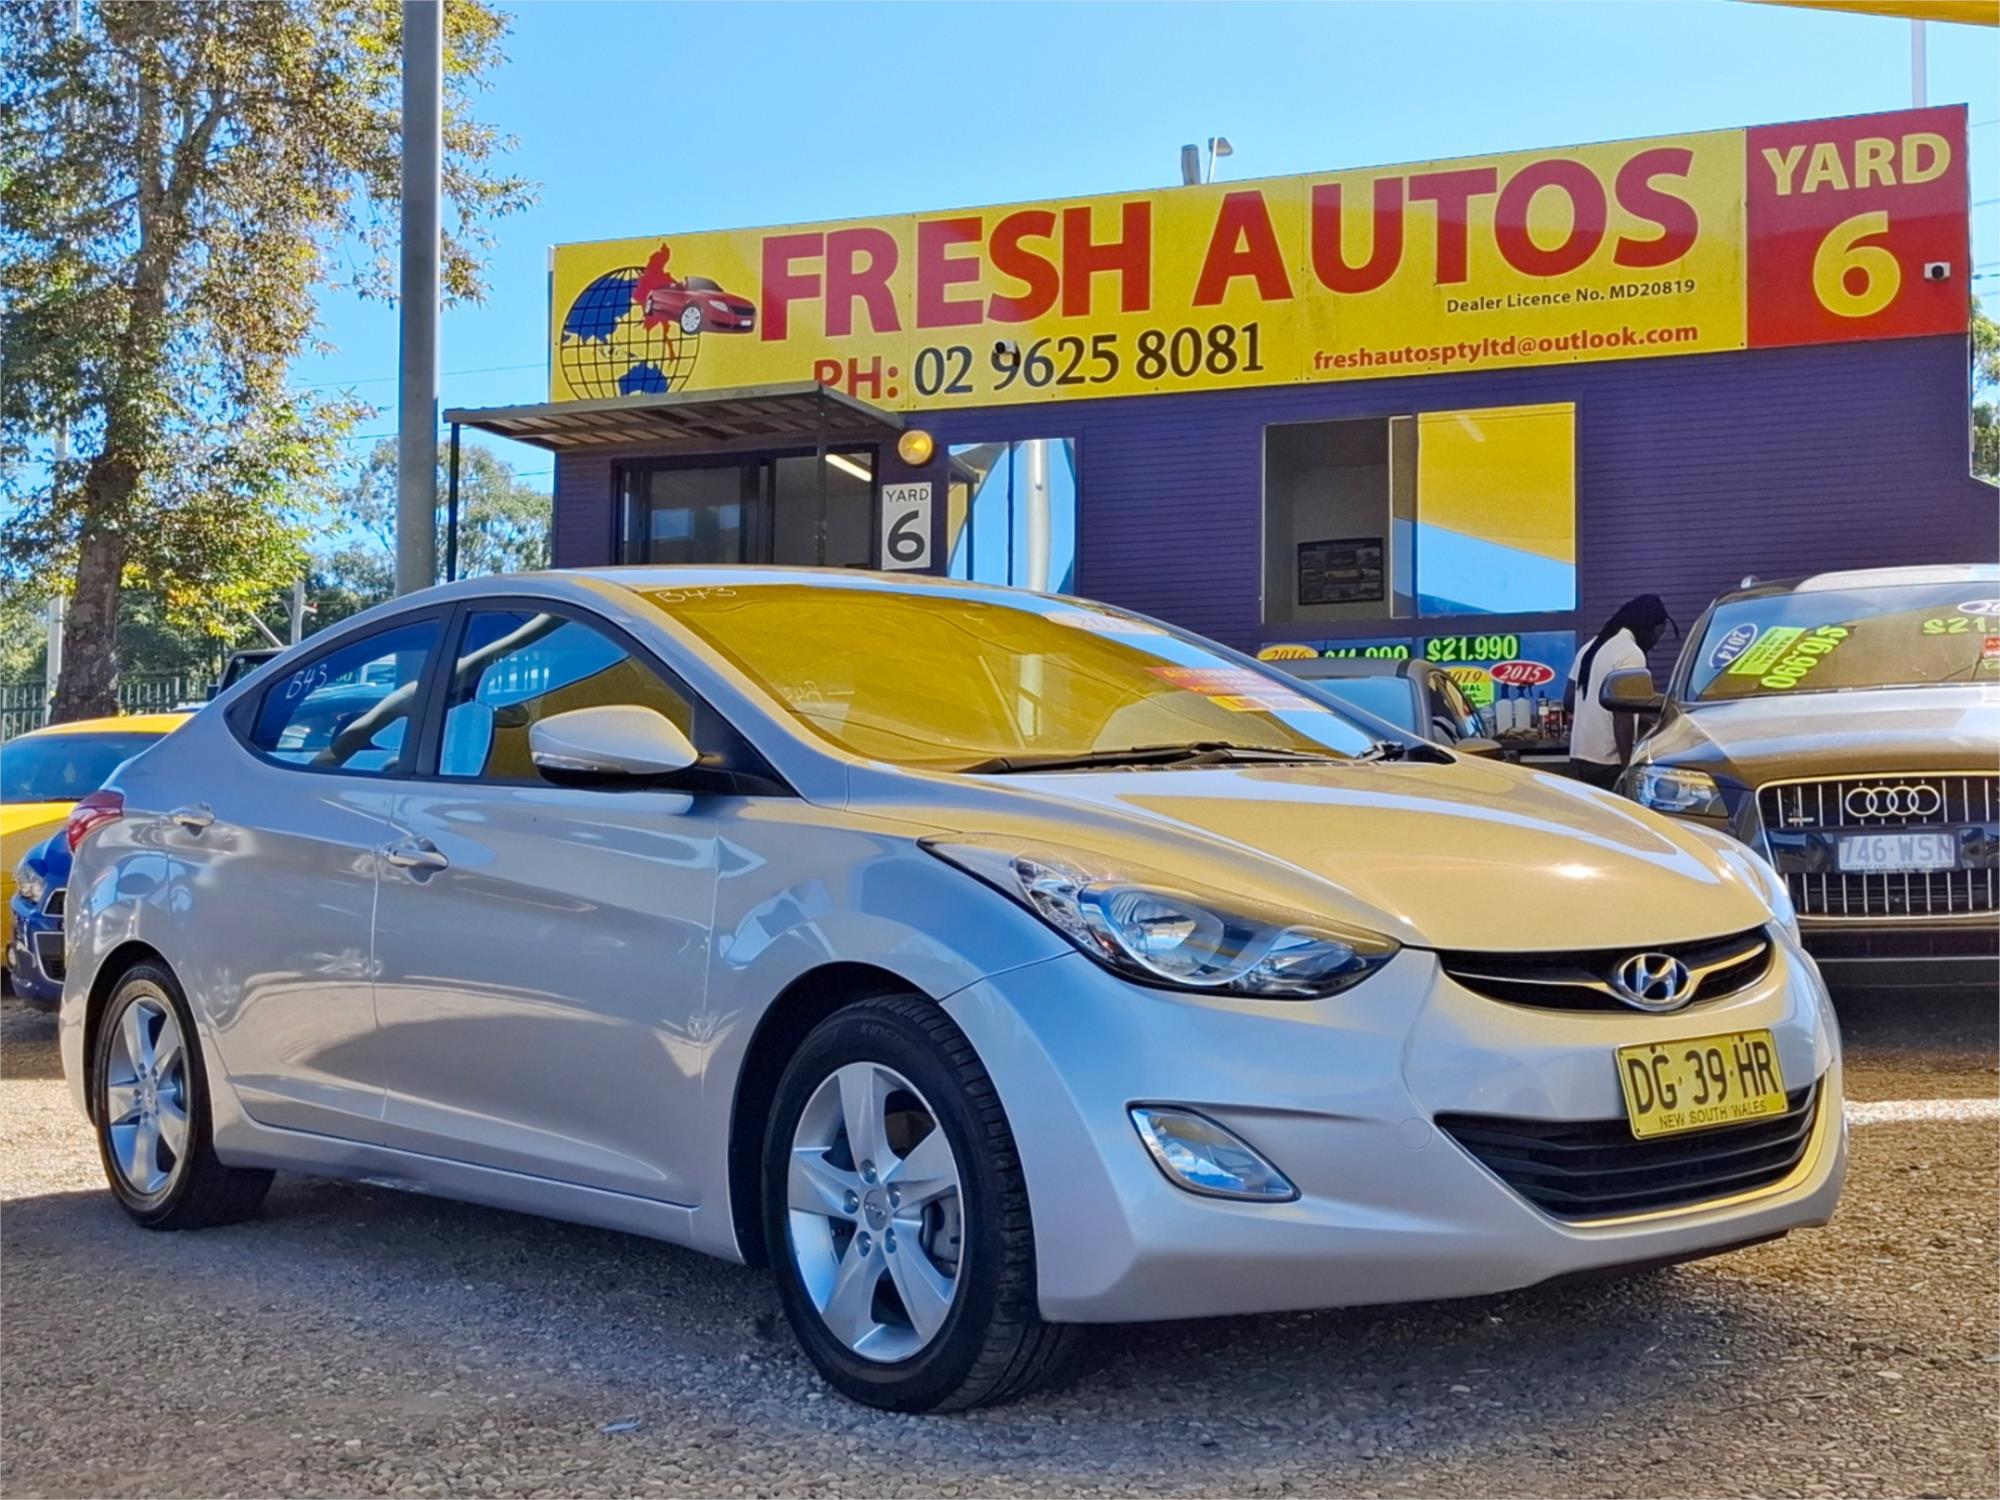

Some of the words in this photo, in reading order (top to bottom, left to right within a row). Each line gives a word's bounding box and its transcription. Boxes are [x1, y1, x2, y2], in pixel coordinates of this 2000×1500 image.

[1761, 132, 1952, 196] YARD
[760, 200, 1152, 342] FRESH
[1191, 147, 1700, 307] AUTOS
[1812, 210, 1901, 318] 6
[1446, 296, 1503, 313] Dealer
[1506, 291, 1572, 308] Licence
[1575, 287, 1605, 303] No.
[1609, 280, 1696, 300] MD20819
[812, 356, 900, 400] PH:
[913, 345, 974, 396] 02
[990, 334, 1120, 392] 9625
[1134, 321, 1265, 381] 8081
[1313, 325, 1699, 370] freshautosptyltd@outlook.com
[885, 488, 930, 503] YARD
[887, 509, 926, 563] 6
[1718, 629, 1751, 660] 2014
[1499, 663, 1543, 682] 2015
[1659, 1113, 1686, 1129] NEW
[1689, 1106, 1728, 1124] SOUTH
[1730, 1100, 1768, 1118] WALES
